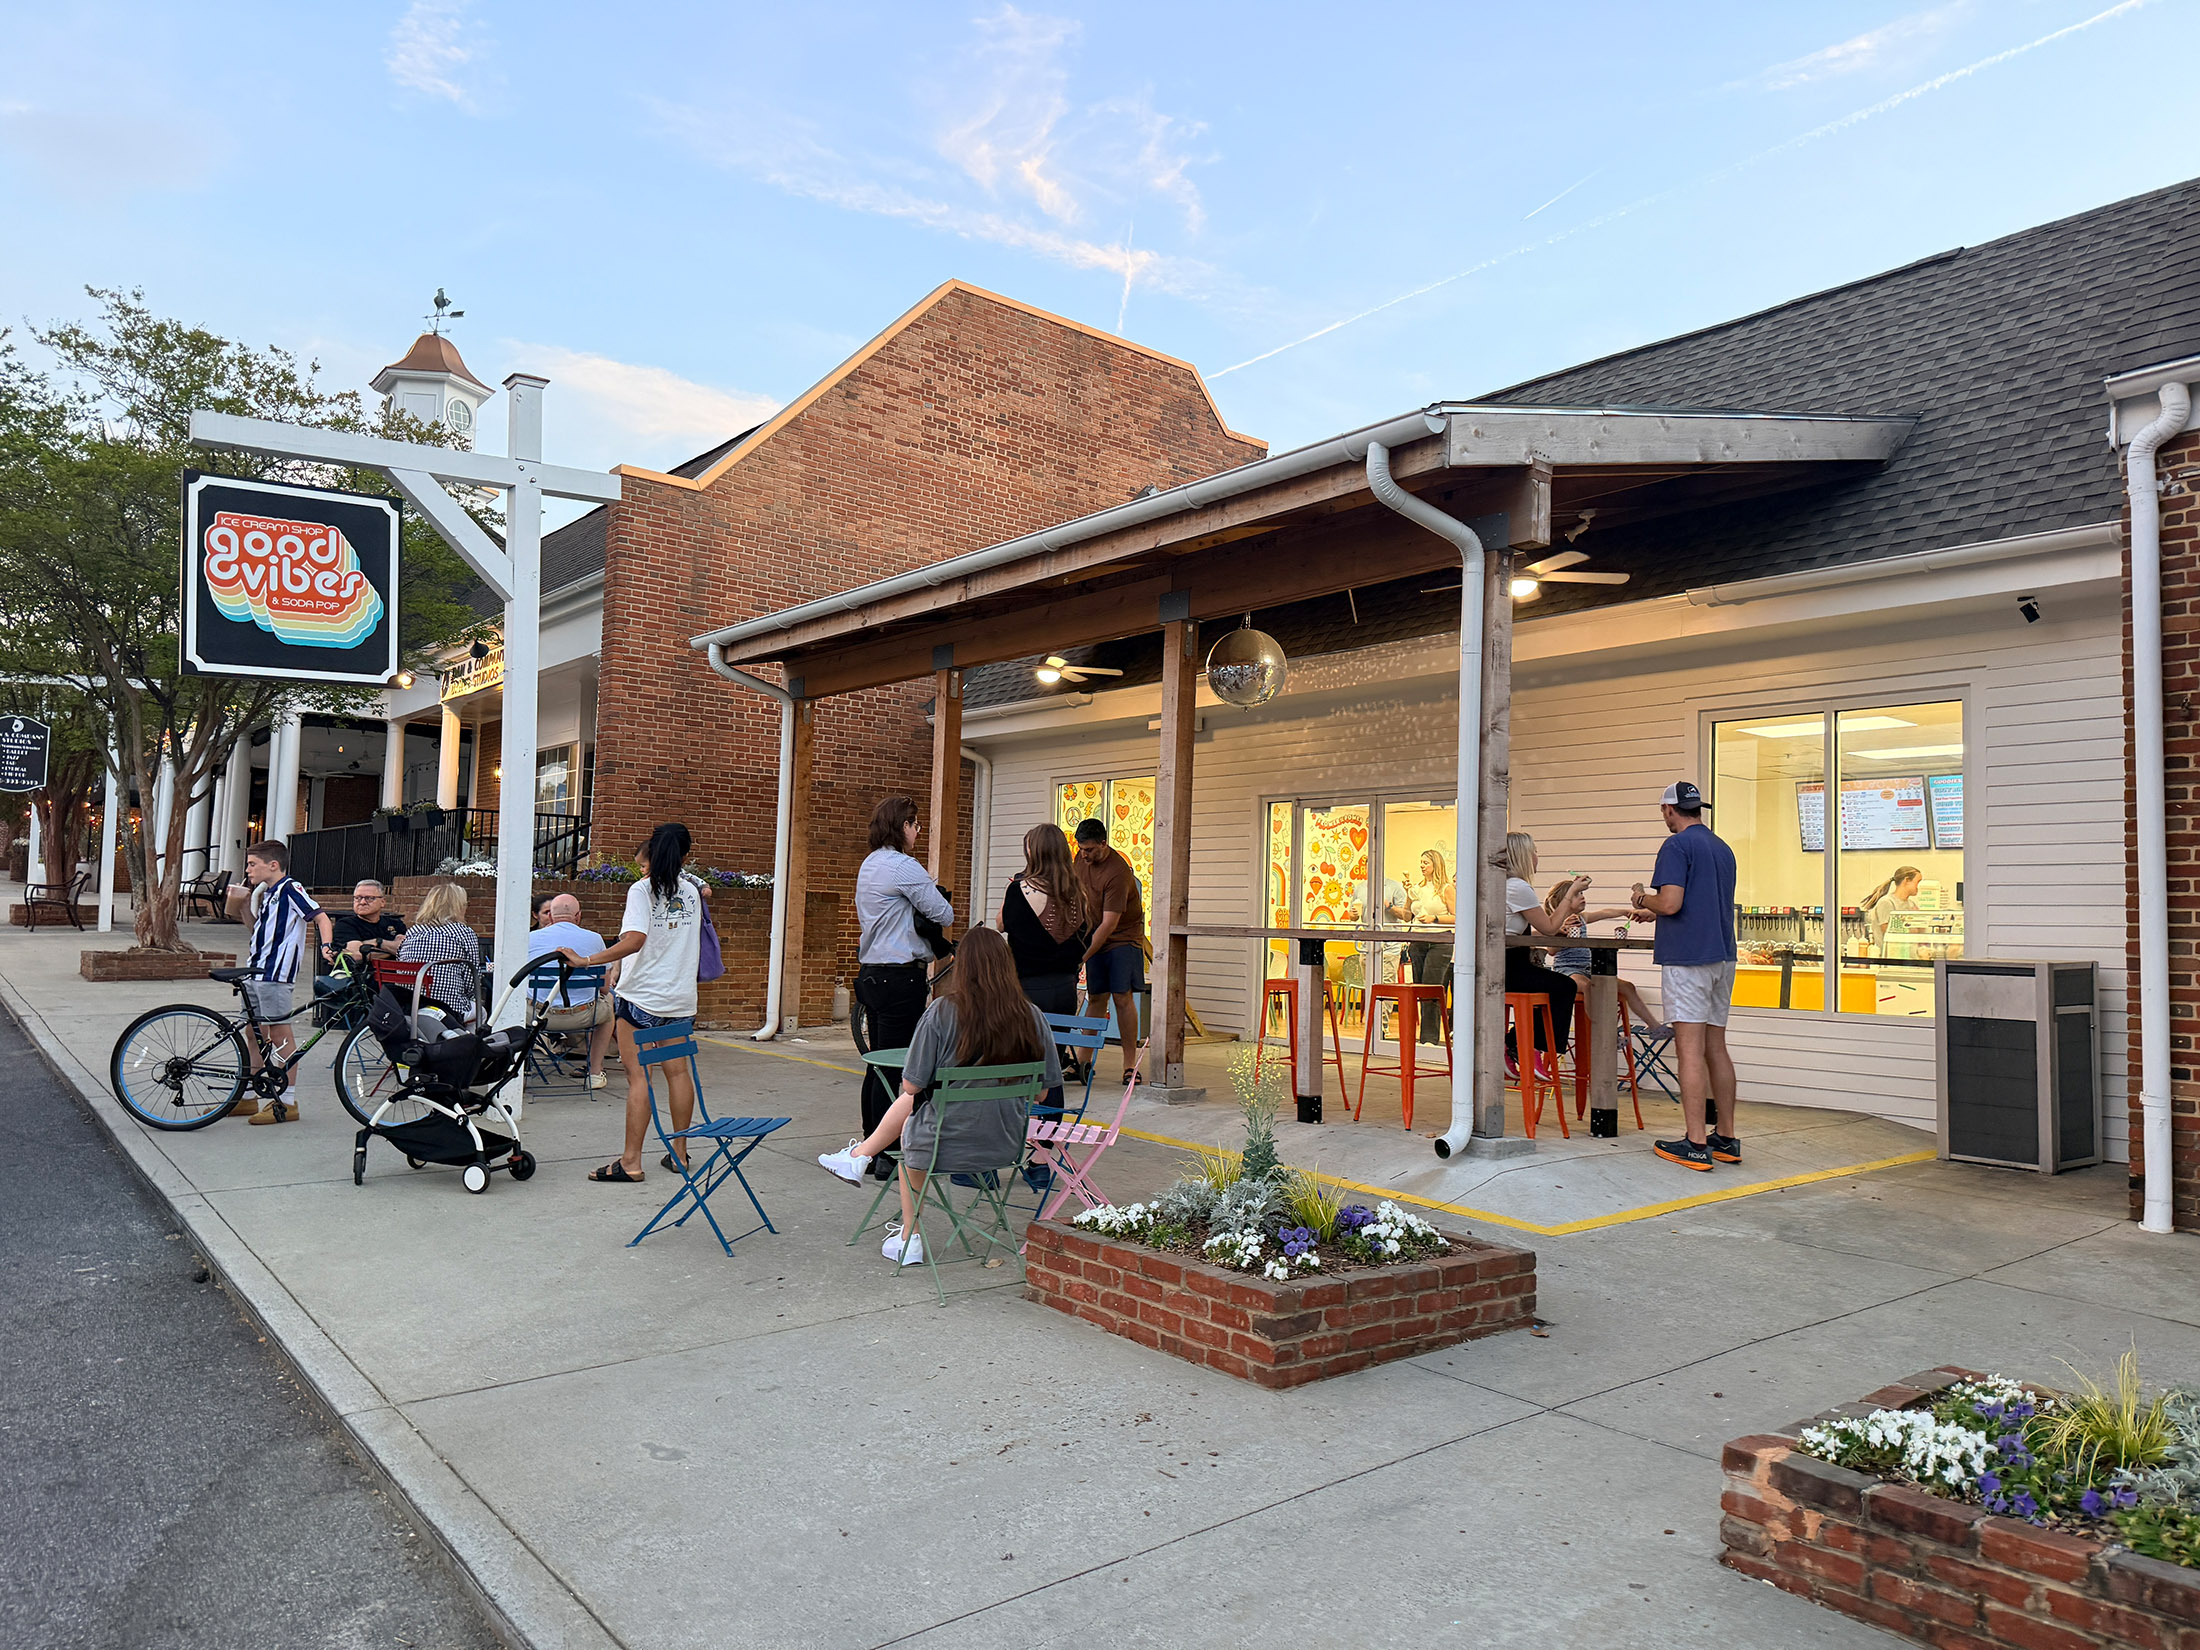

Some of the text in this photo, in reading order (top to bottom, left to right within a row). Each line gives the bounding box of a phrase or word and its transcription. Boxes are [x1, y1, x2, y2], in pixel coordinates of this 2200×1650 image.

[220, 516, 324, 536] ICE CREAM SHOP
[209, 527, 338, 580] good
[241, 554, 361, 598] vibes
[271, 597, 340, 610] & SODA POP
[468, 660, 472, 674] &
[473, 666, 499, 687] STUDIOS
[1688, 1151, 1708, 1160] HOKA
